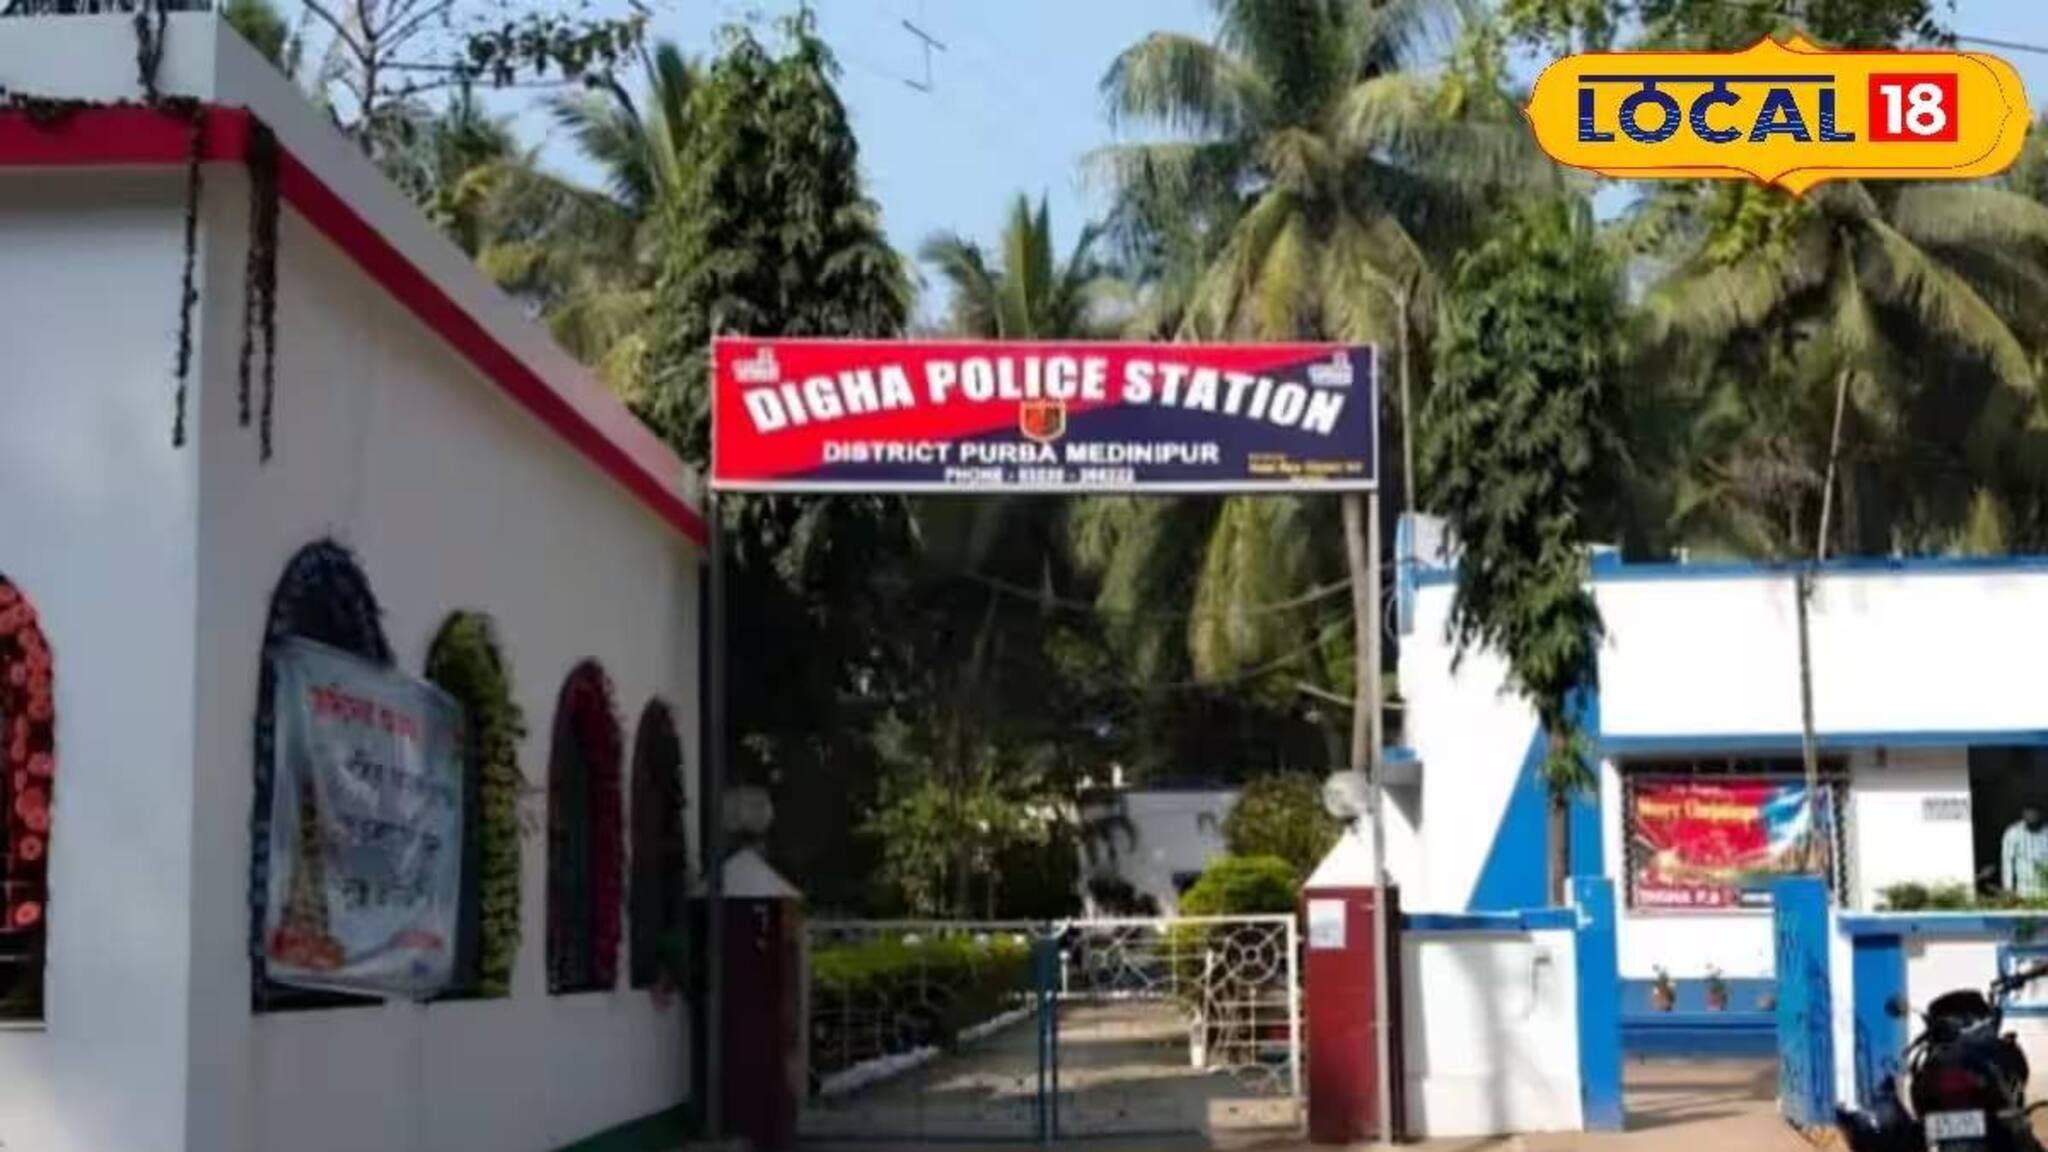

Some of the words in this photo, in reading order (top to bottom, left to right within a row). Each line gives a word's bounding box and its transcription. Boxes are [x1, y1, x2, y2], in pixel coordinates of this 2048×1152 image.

[743, 364, 915, 434] DIGHA
[925, 356, 1108, 404] POLICE
[1122, 359, 1345, 434] STATION
[823, 441, 952, 463] DISTRICT
[960, 441, 1059, 464] PURBA
[1065, 442, 1221, 465] MEDINIPUR
[945, 467, 1003, 483] PHONE
